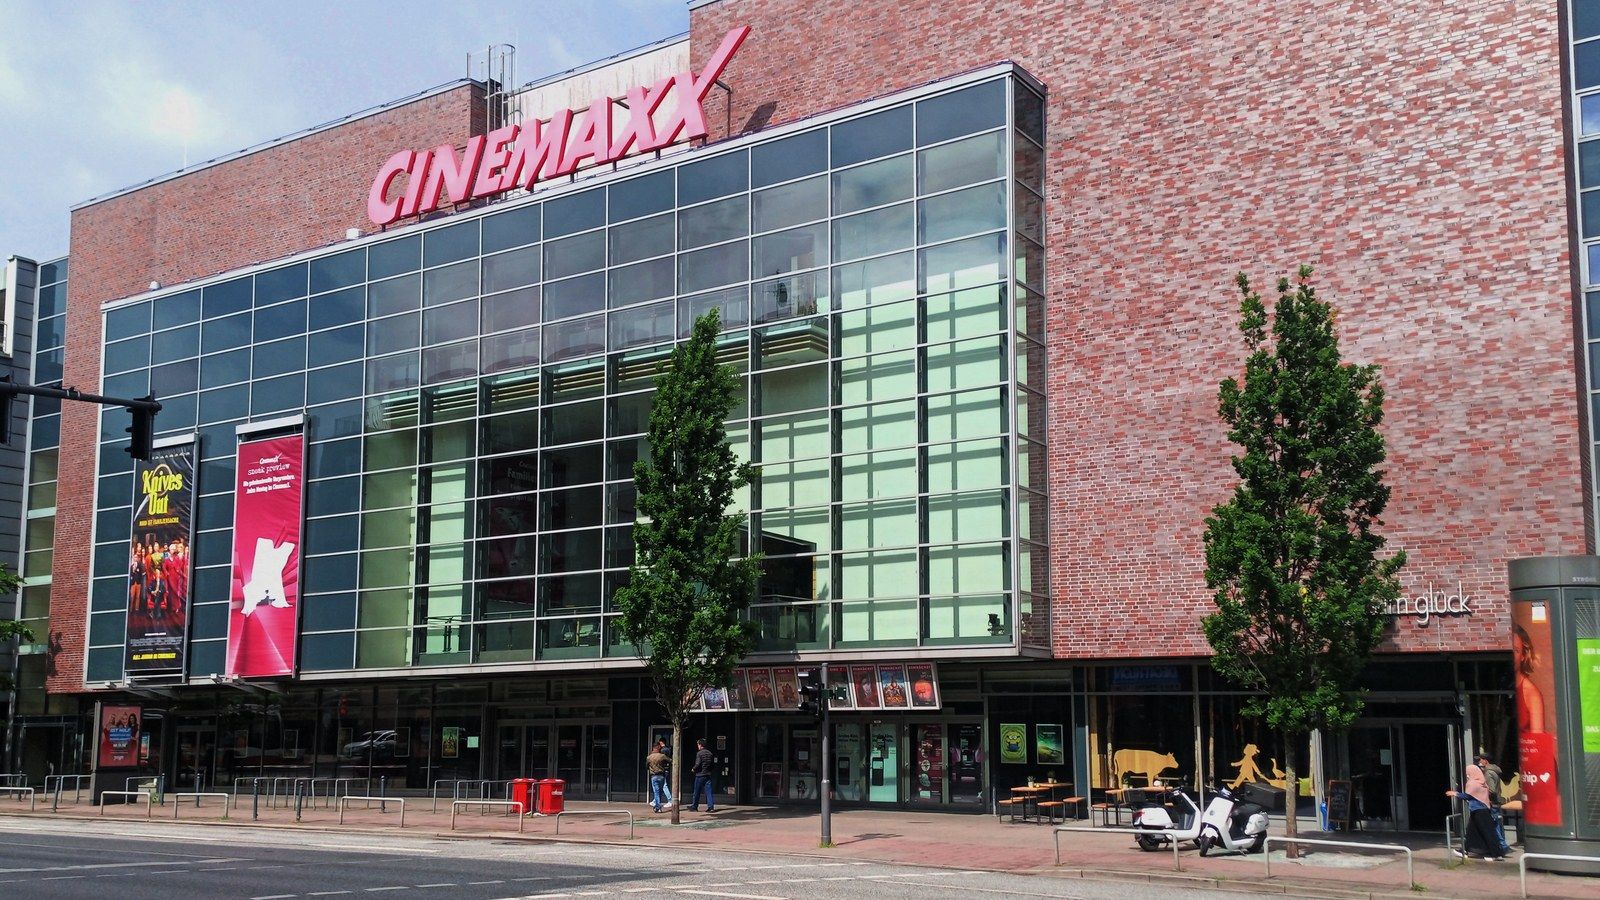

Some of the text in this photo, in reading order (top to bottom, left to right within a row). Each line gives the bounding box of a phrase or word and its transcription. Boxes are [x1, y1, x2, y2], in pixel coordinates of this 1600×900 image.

[367, 25, 751, 225] CINEMAXX
[266, 463, 290, 474] preview
[142, 470, 183, 494] Knives
[148, 492, 169, 515] Out
[1415, 580, 1472, 625] glück
